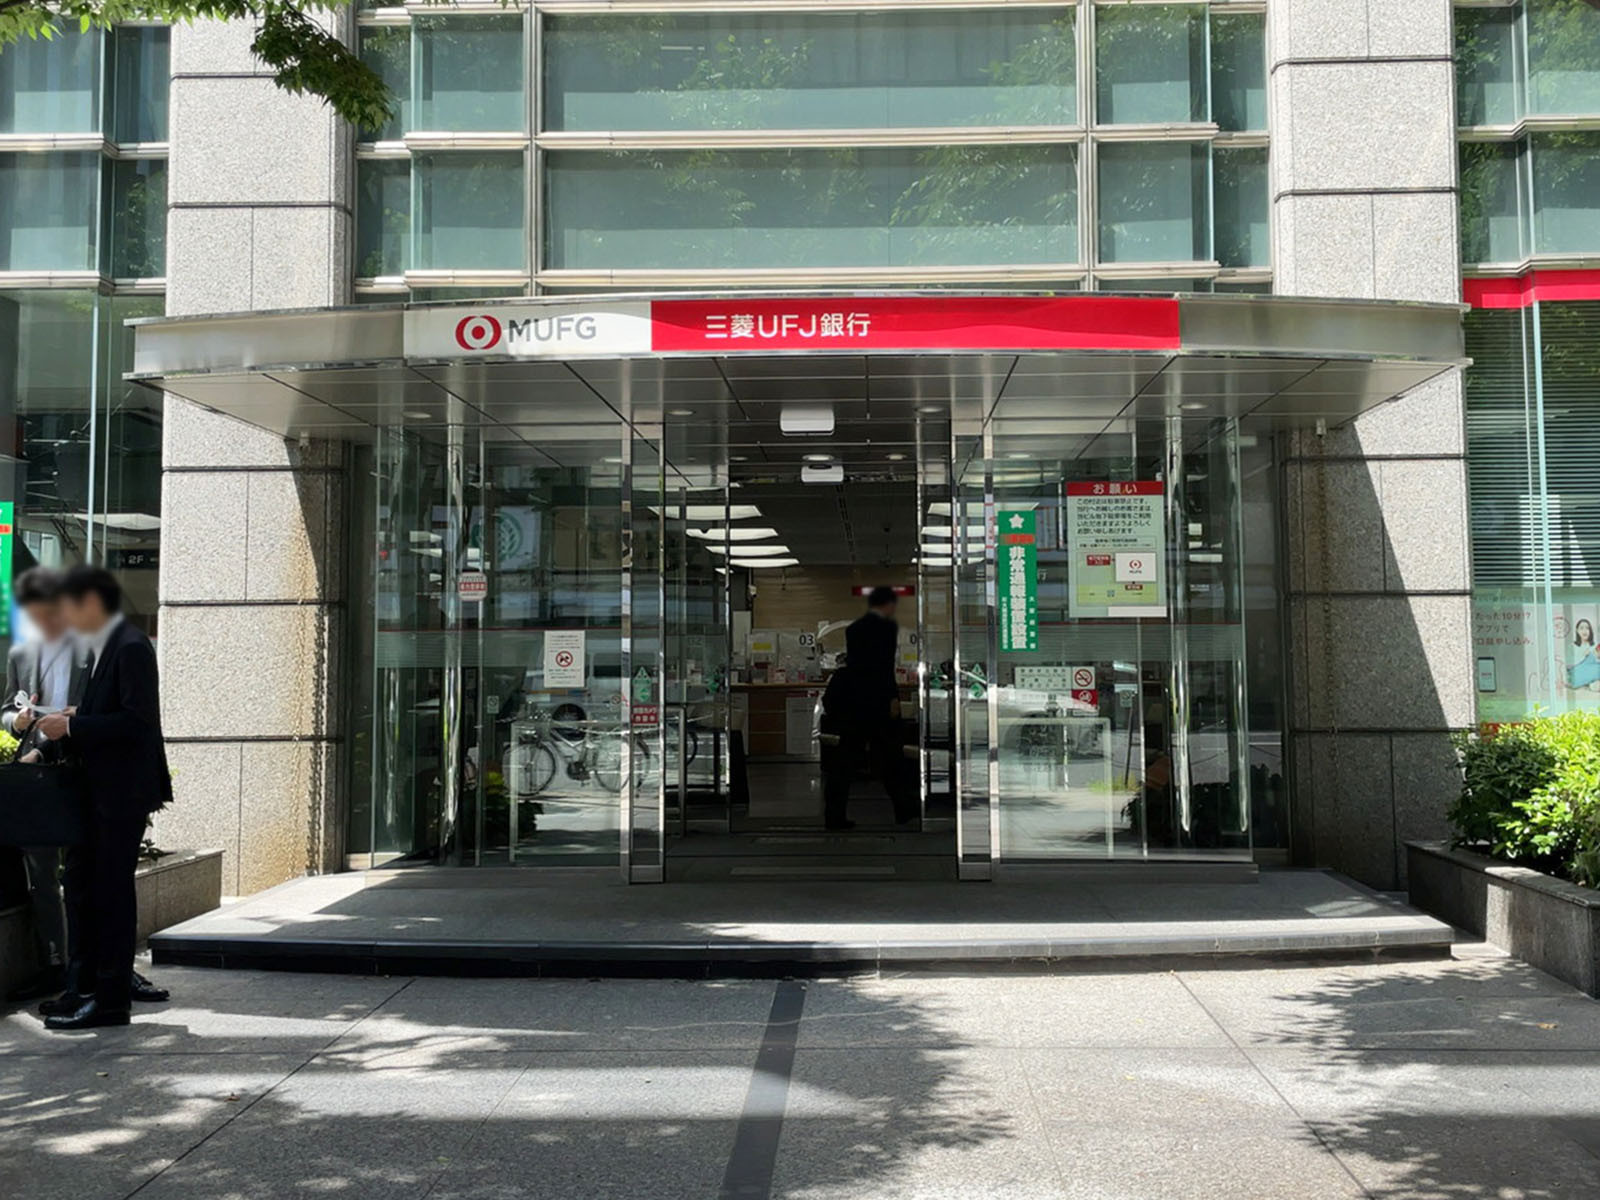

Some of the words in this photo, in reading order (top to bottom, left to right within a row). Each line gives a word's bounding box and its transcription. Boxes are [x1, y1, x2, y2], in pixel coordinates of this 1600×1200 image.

[508, 316, 596, 343] MUFG
[704, 312, 871, 340] 三菱UFJ銀行
[1093, 483, 1137, 495] お願い
[128, 555, 145, 565] 2F
[799, 634, 814, 646] 03
